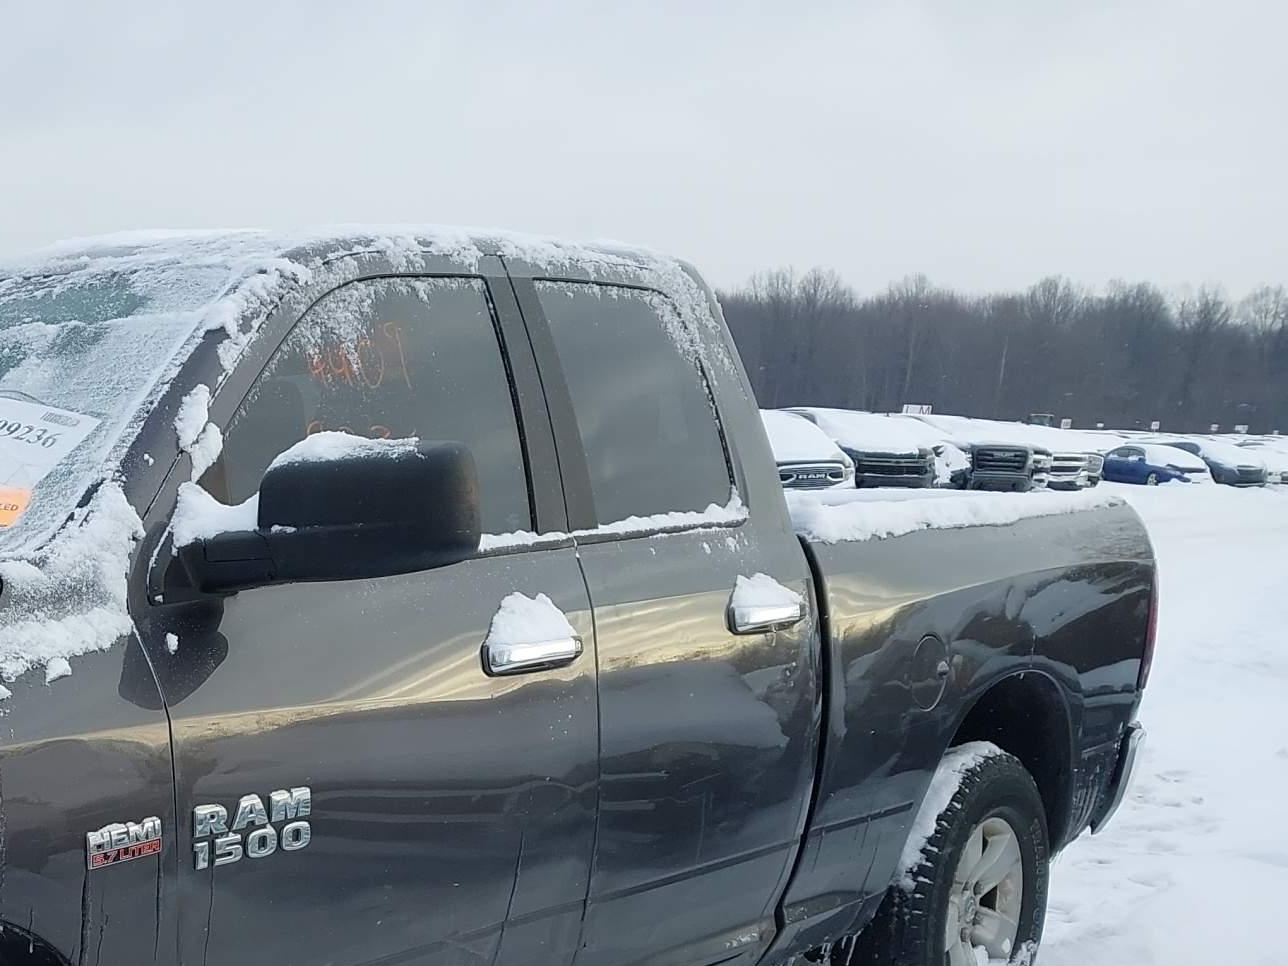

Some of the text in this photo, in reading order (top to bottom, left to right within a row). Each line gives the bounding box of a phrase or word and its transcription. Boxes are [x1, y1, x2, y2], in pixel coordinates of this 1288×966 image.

[194, 787, 311, 838] RAM
[87, 817, 161, 853] HEMI
[93, 840, 160, 867] 5.7 LITER
[194, 820, 311, 870] 1500
